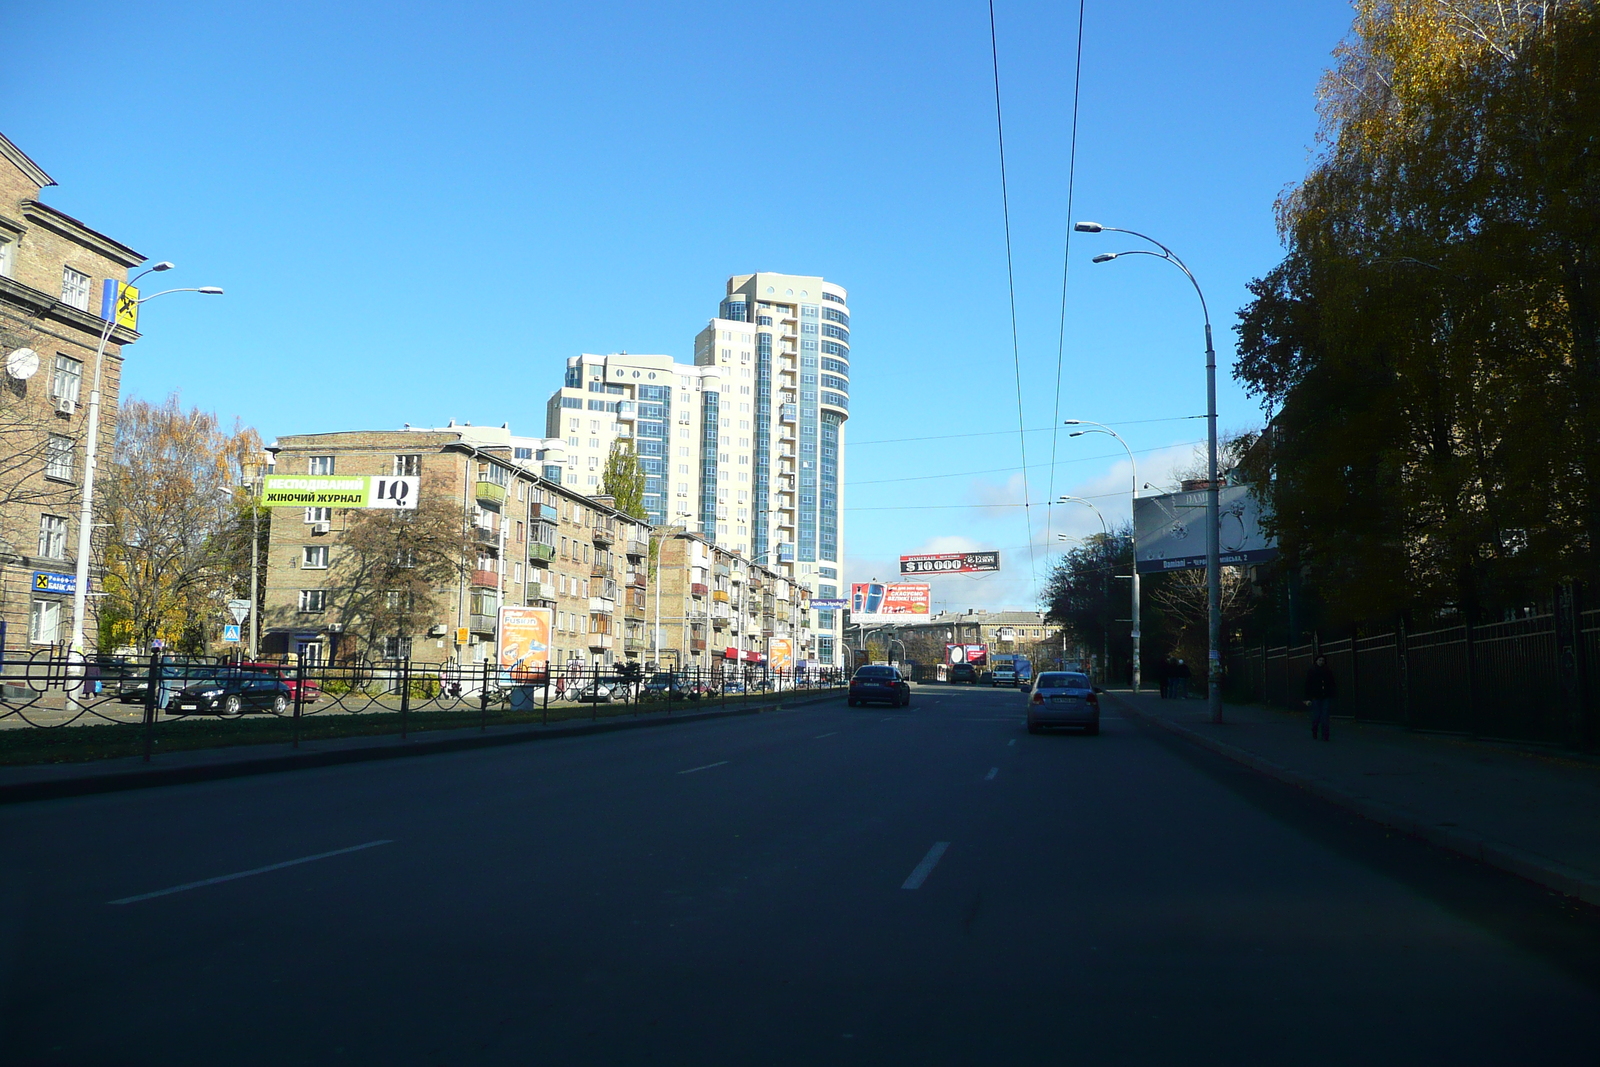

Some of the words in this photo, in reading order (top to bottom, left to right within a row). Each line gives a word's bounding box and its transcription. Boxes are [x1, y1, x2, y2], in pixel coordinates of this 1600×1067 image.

[267, 477, 364, 491] НЕСПОДІВАНИЙ
[267, 492, 315, 503] ЖІНОЧИЙ
[317, 494, 362, 503] ЖУРНАЛ
[1186, 492, 1225, 504] DAMII
[1163, 558, 1185, 568] Damiani
[48, 582, 66, 591] БАНК
[504, 616, 536, 625] Fusion
